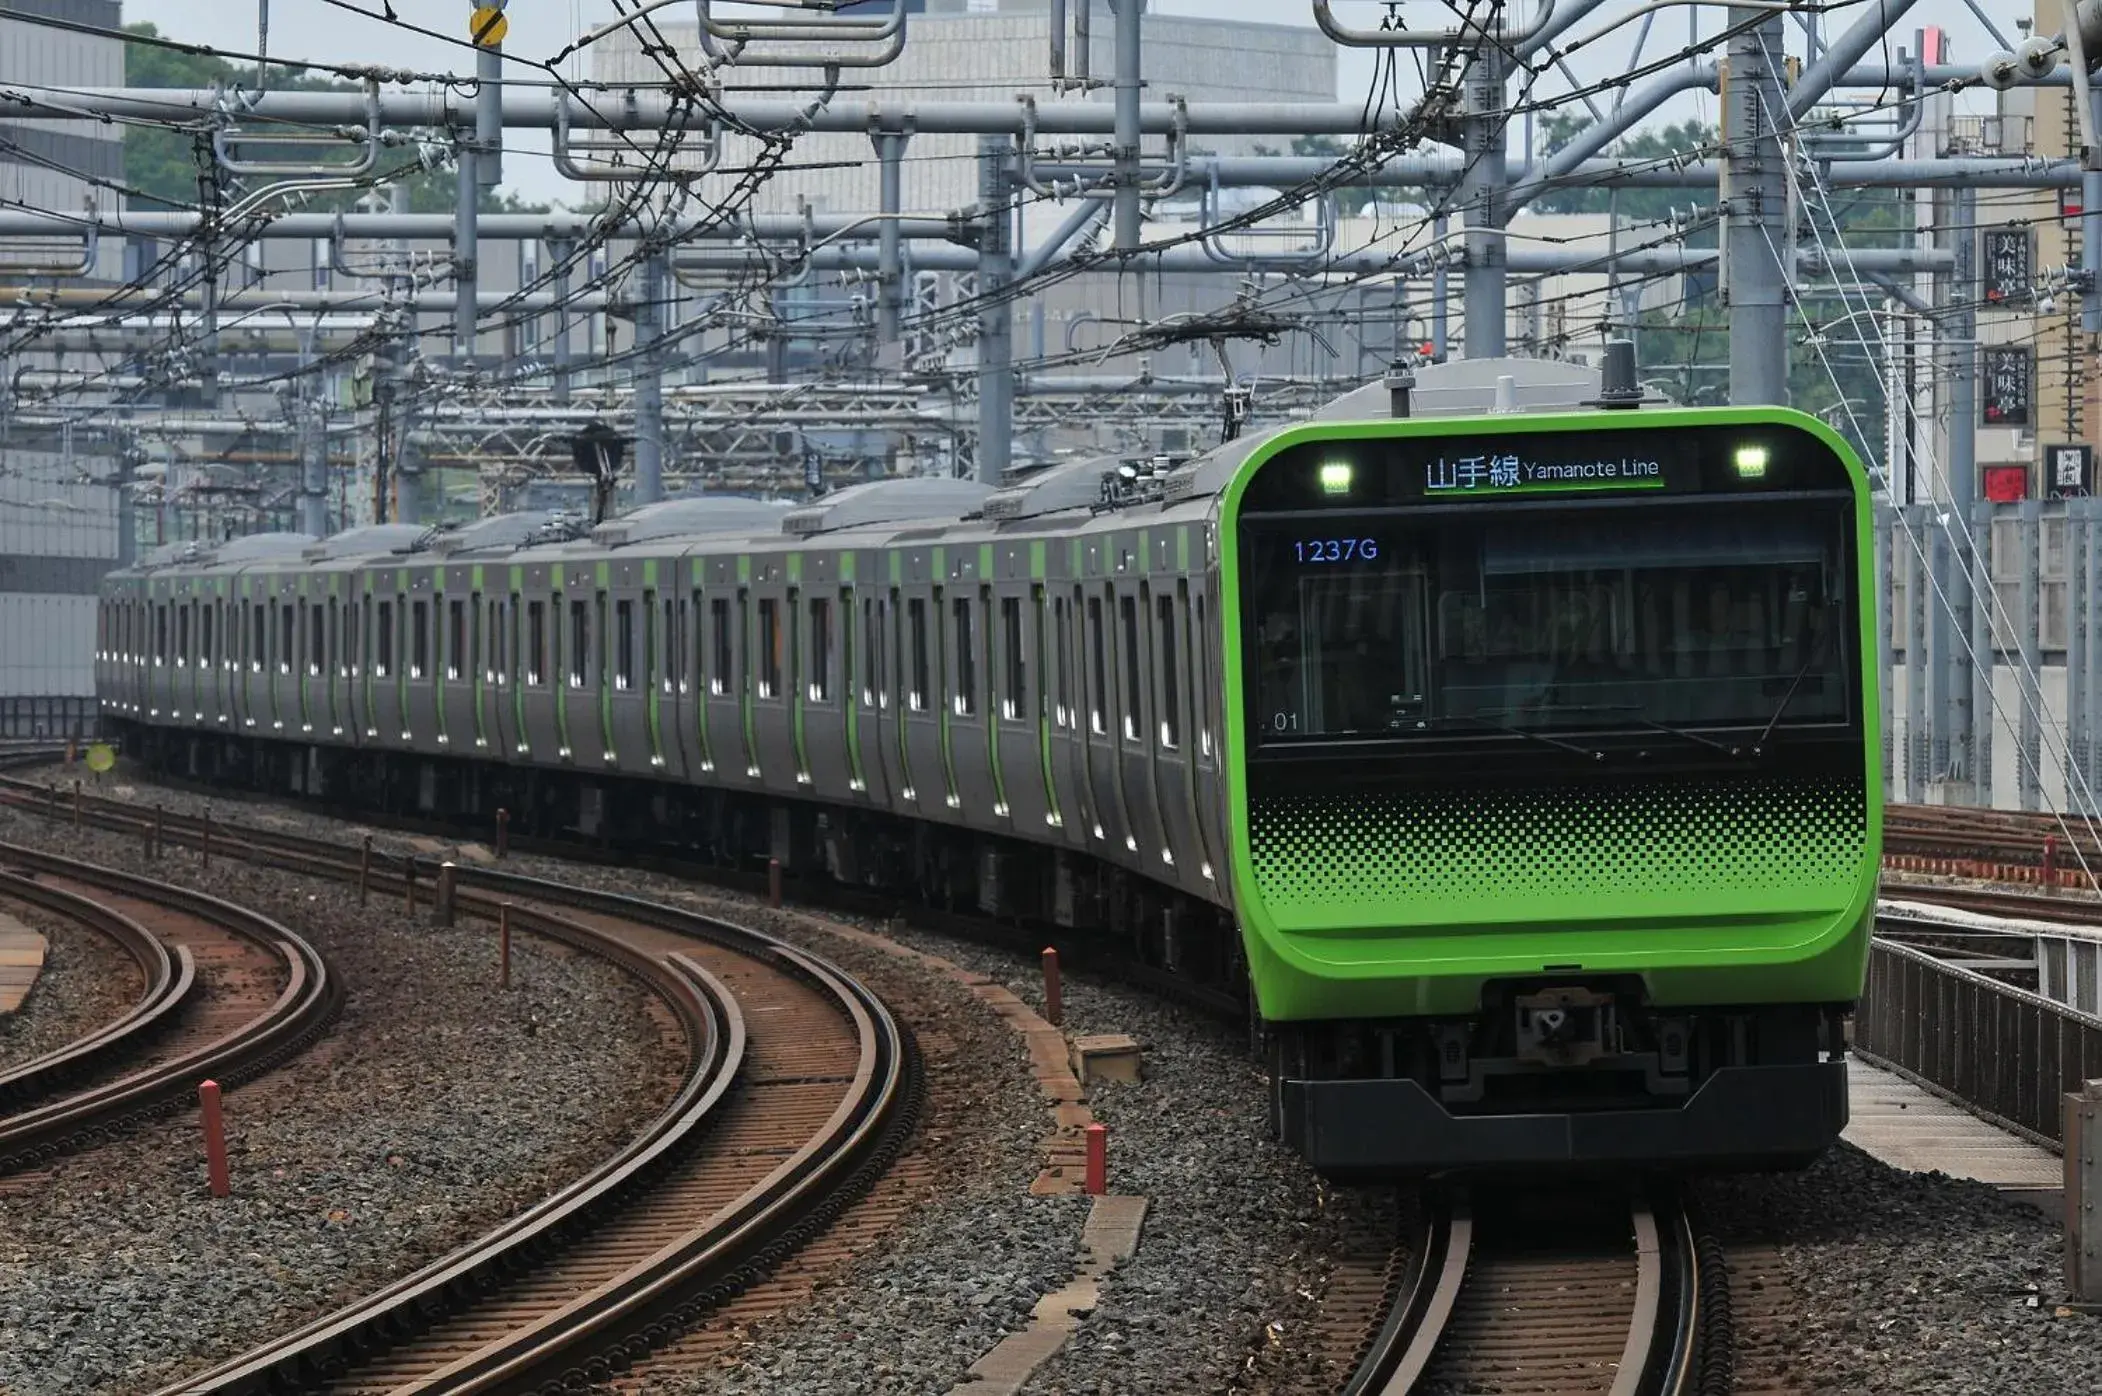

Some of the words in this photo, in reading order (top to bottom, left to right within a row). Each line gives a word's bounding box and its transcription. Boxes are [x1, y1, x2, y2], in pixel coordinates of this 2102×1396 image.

[1427, 455, 1521, 488] 山手線
[1523, 461, 1617, 480] Yamanote
[1622, 458, 1660, 476] Line
[1294, 538, 1378, 562] 1237G
[1274, 712, 1297, 731] 01
